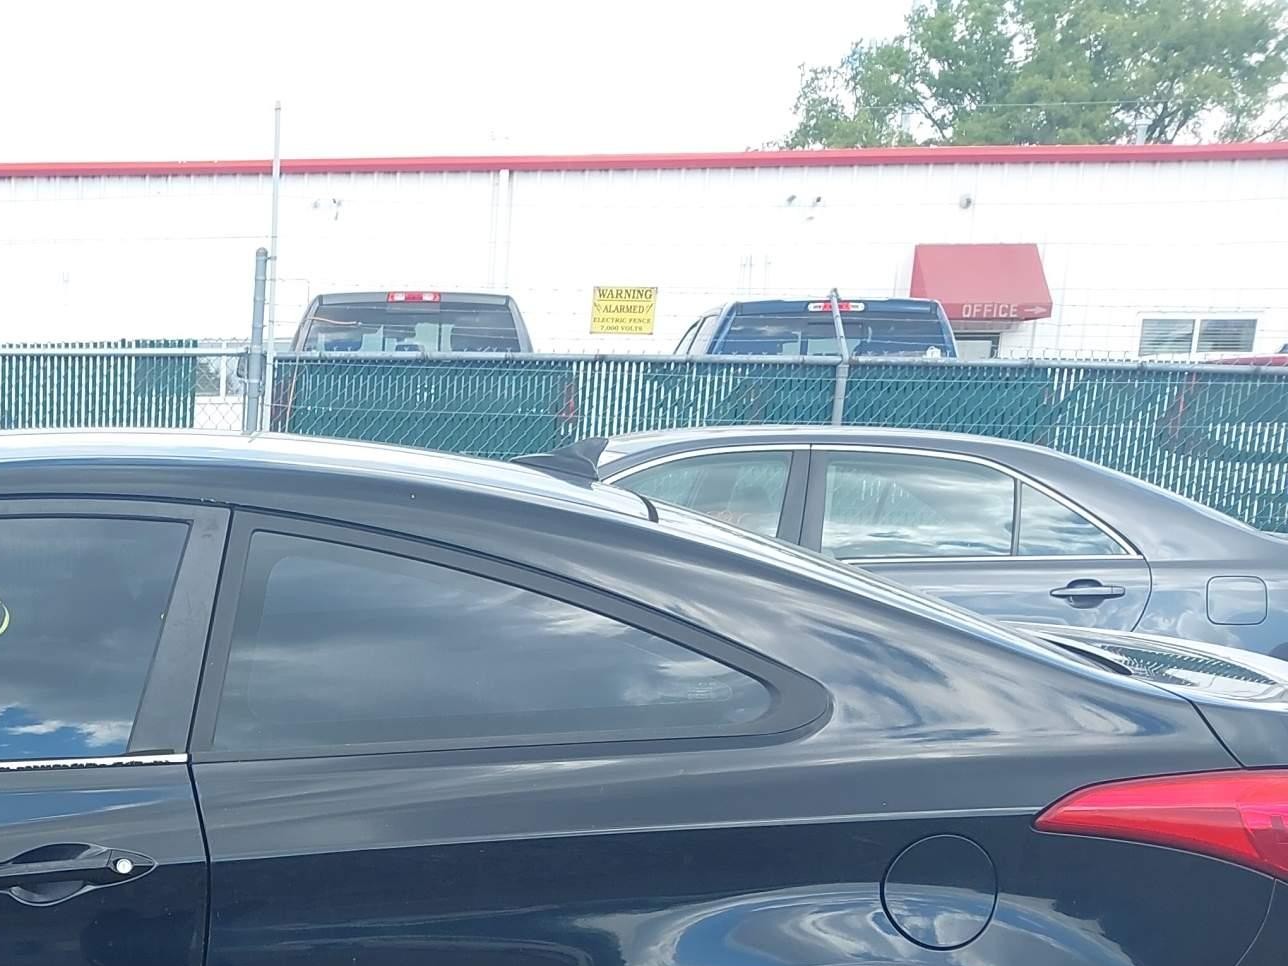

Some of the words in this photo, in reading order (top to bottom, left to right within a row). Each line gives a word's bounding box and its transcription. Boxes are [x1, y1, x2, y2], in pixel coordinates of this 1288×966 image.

[598, 288, 652, 299] WARNING
[602, 304, 645, 313] ALARMED
[962, 303, 1018, 318] OFFICE
